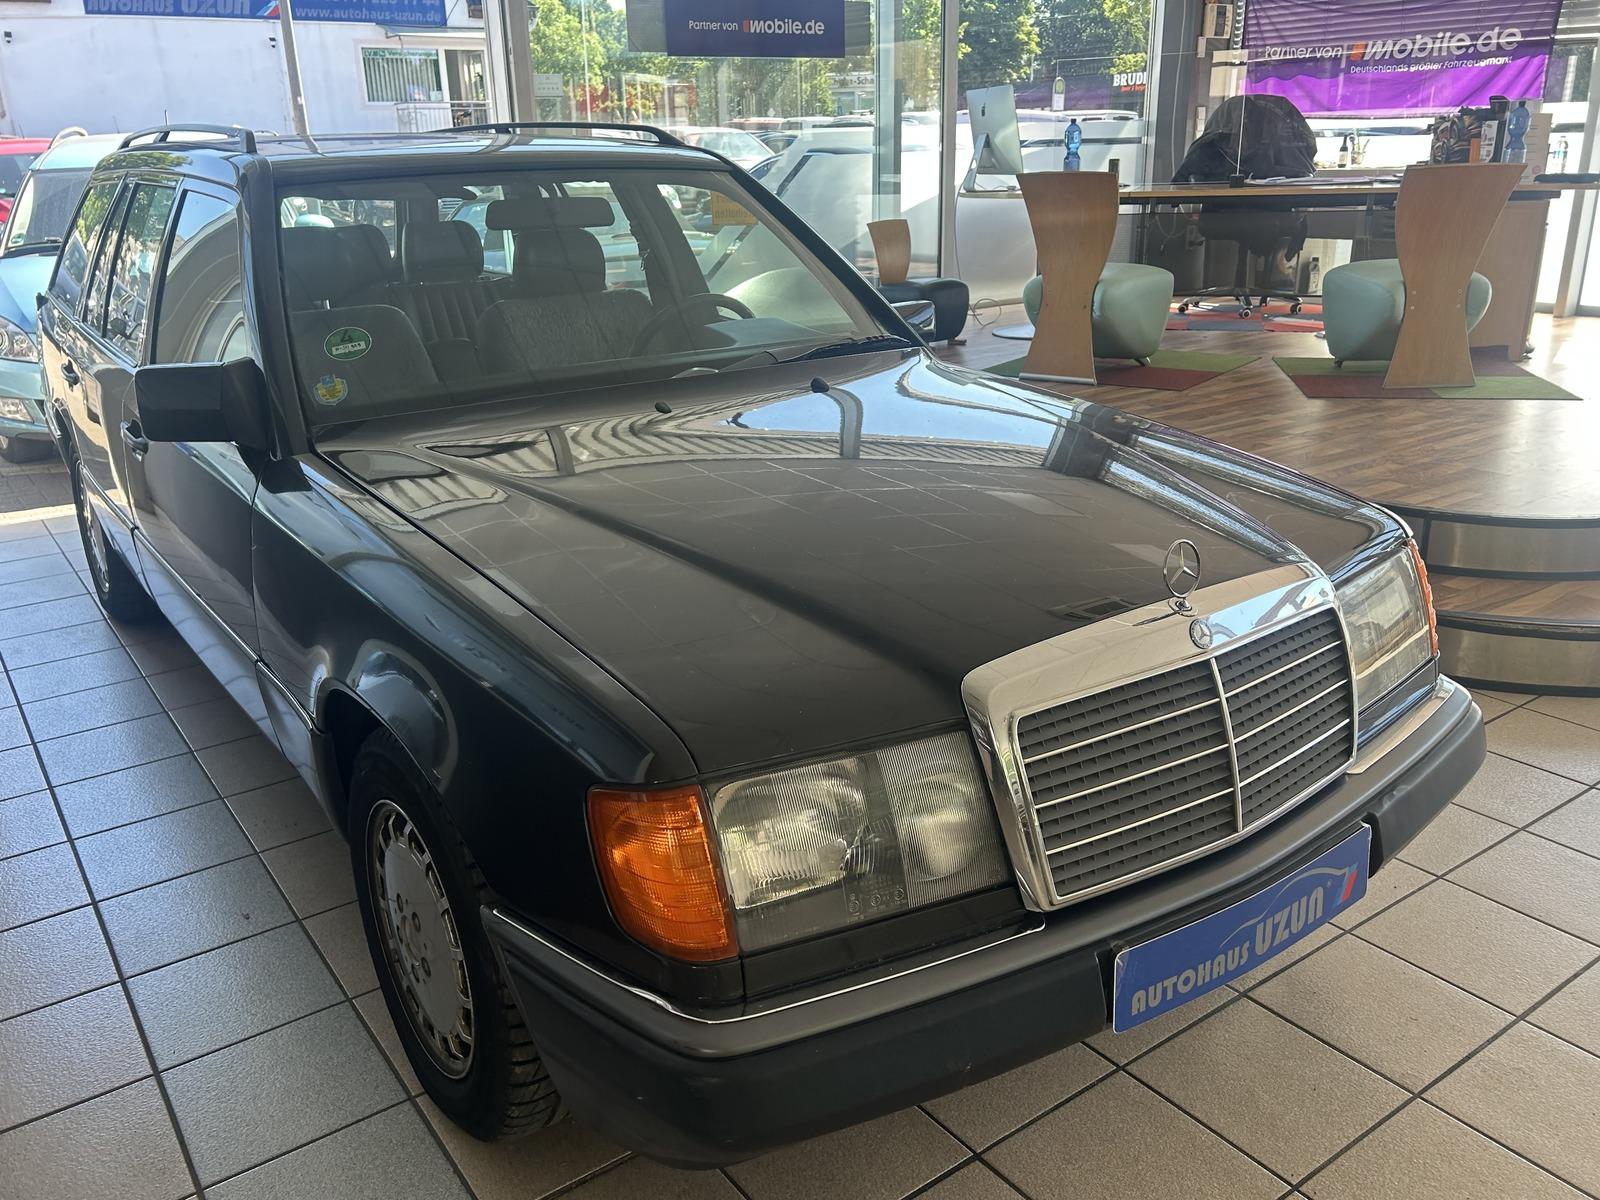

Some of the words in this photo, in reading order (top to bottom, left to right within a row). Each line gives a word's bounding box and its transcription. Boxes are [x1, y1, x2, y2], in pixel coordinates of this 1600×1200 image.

[295, 7, 441, 21] www.autohaus-uzun.de
[688, 20, 720, 31] Partner
[722, 22, 739, 31] von
[749, 18, 825, 35] mobile.de
[1265, 46, 1313, 59] Partner
[1314, 45, 1343, 59] von
[1362, 26, 1522, 61] mobile.de
[1350, 63, 1409, 74] Deutschlands
[1409, 61, 1442, 72] größter
[1443, 55, 1513, 69] Fahrzeugmarkt
[1131, 940, 1250, 1017] AUTOHAUS
[1255, 885, 1324, 956] UZUN
